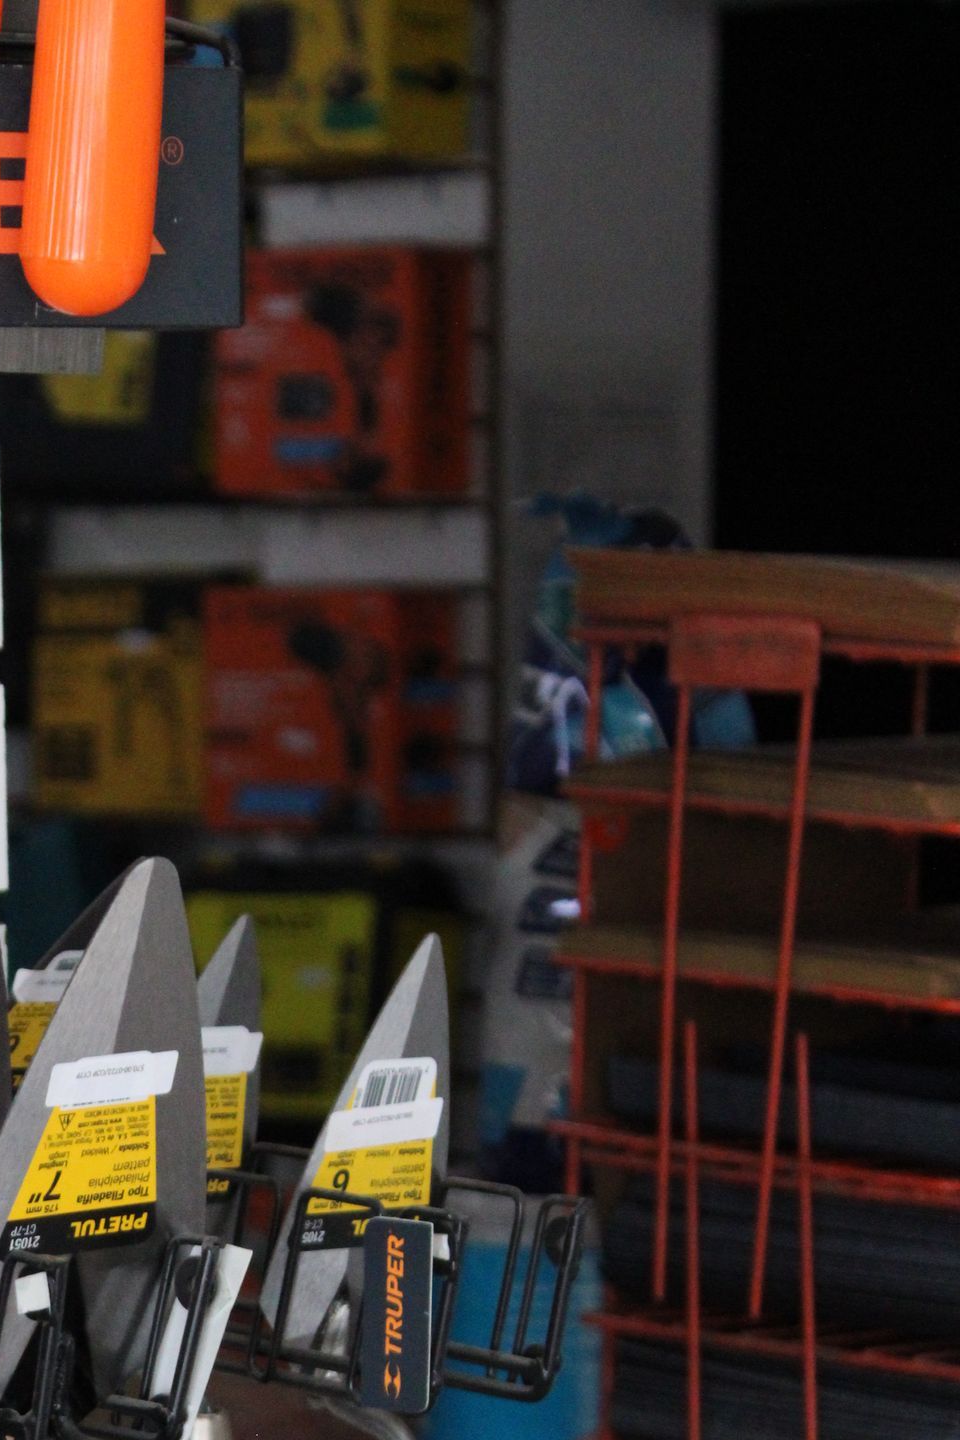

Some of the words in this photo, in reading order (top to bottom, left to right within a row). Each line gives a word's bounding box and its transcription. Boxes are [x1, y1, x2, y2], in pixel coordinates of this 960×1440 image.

[80, 1146, 109, 1157] Welded
[118, 1141, 149, 1152] Soldada
[112, 1156, 150, 1170] pattern
[392, 1162, 425, 1174] pattern
[87, 1172, 150, 1187] Philadelphia
[370, 1175, 424, 1188] Philadelphia
[76, 1188, 124, 1204] Filadelfia
[127, 1185, 149, 1196] Tipo
[403, 1189, 422, 1199] Tipo
[25, 1205, 42, 1214] mm
[43, 1203, 58, 1211] 175
[9, 1223, 36, 1235] CT-7P
[69, 1211, 148, 1237] PRETUL
[8, 1234, 40, 1250] 21051
[385, 1234, 406, 1355] TRUPER
